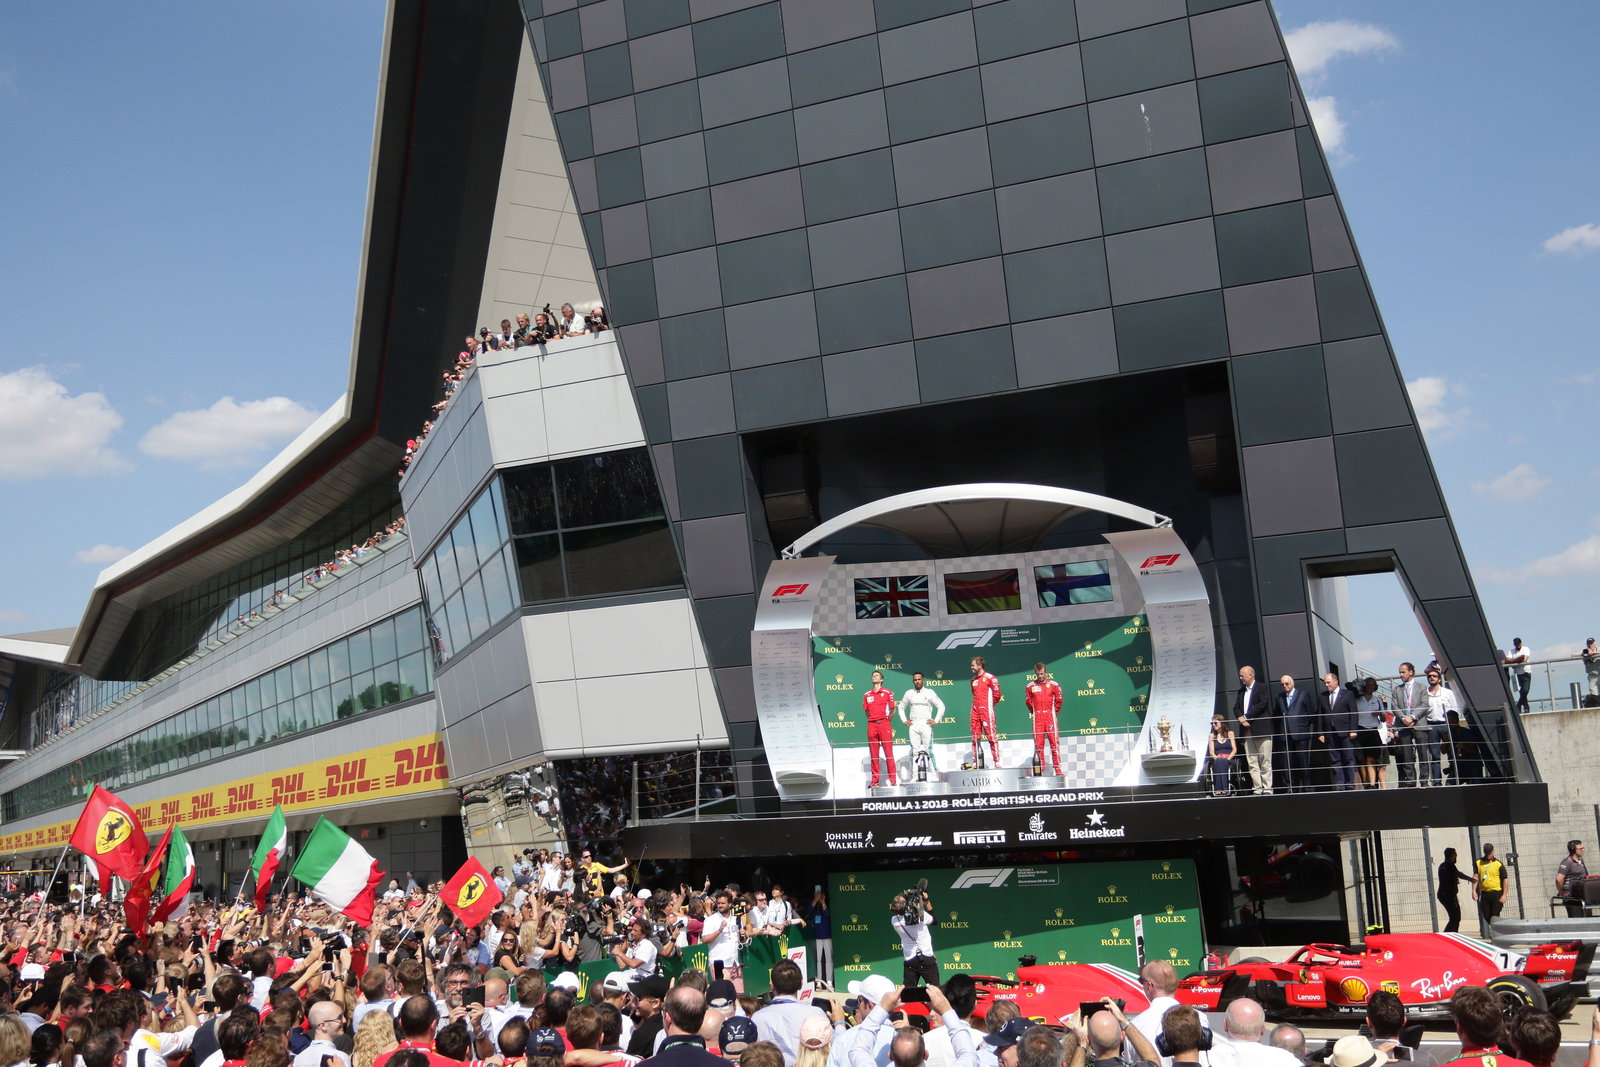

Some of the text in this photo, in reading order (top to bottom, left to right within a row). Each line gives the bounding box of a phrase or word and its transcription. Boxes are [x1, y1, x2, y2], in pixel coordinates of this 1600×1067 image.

[1123, 626, 1151, 635] ROLEX
[1075, 650, 1103, 658] ROLEX
[1126, 665, 1153, 673] ROLEX
[1077, 688, 1105, 696] ROLEX
[1080, 727, 1108, 735] ROLEX
[161, 800, 182, 825] DHL
[192, 792, 216, 820] DHL
[228, 783, 257, 814] DHL
[271, 772, 308, 806] DHL
[325, 758, 372, 798] DHL
[862, 791, 1104, 811] FORMULA 1 2018 ROLEX BRITISH GRAND PRIX
[825, 832, 863, 842] JOHNNIE
[953, 830, 1006, 845] PIRELLI
[1018, 831, 1057, 842] Emirates
[1069, 826, 1125, 839] Heineken
[828, 840, 864, 850] WALKER
[892, 836, 936, 847] DHL
[839, 884, 866, 892] ROLEX
[1101, 938, 1132, 946] ROLEX
[943, 962, 972, 970] ROLEX
[1500, 953, 1509, 969] 7
[1411, 970, 1467, 999] Ray-Ban
[1298, 993, 1321, 1001] Lenovo
